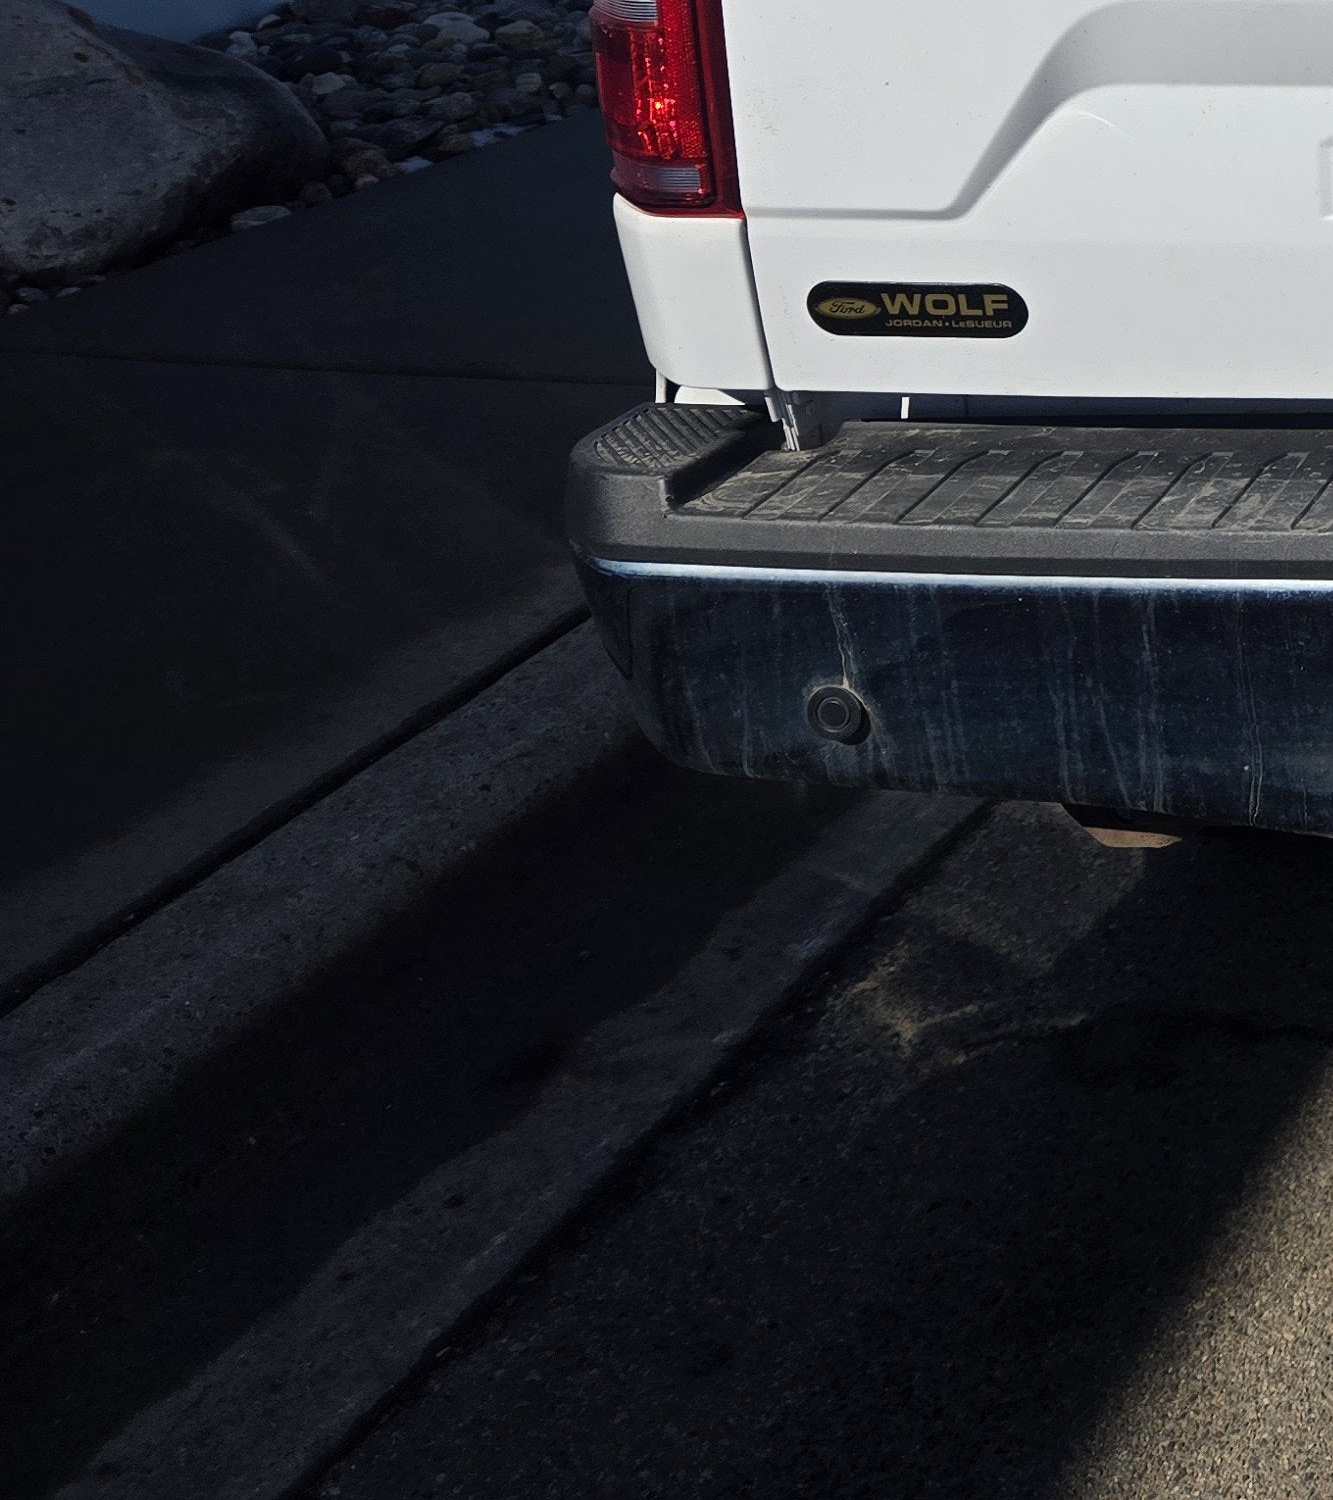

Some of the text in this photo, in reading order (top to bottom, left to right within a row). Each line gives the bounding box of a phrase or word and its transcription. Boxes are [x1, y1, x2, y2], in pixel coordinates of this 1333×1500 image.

[828, 293, 1009, 316] Ford WOLF
[885, 319, 943, 328] JORDAN
